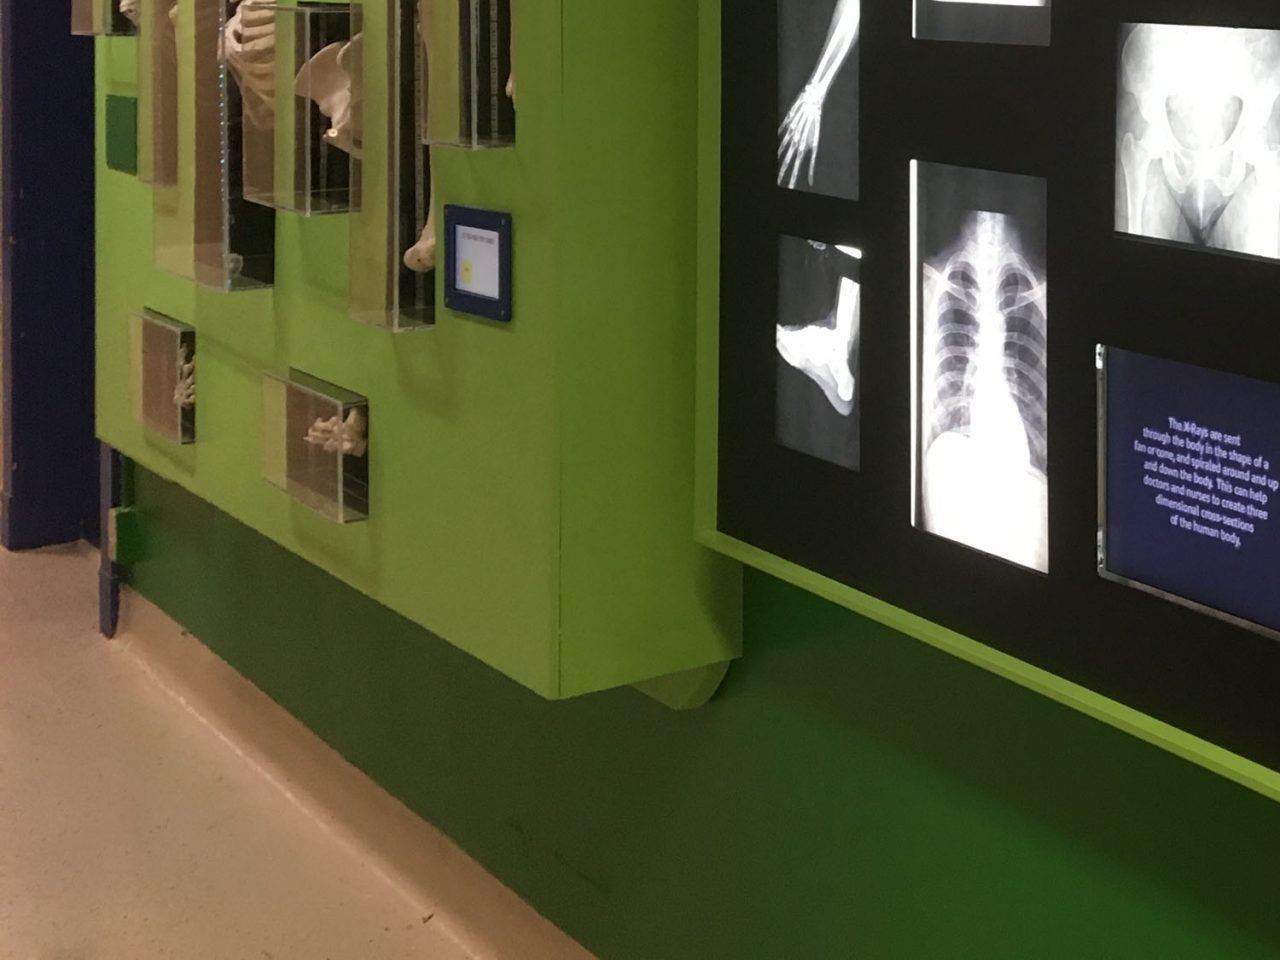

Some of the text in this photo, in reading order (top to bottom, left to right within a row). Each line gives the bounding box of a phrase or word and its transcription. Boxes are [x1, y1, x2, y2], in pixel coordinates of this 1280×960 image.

[1143, 426, 1270, 470] through the body in the shape of a
[1168, 416, 1183, 431] The
[1209, 430, 1223, 442] are
[1223, 434, 1241, 447] sent
[1134, 439, 1147, 453] fan
[1176, 453, 1191, 465] and
[1191, 457, 1221, 474] spiraled
[1222, 466, 1250, 482] around
[1251, 474, 1267, 486] and
[1267, 479, 1279, 492] up
[1143, 460, 1158, 472] and
[1158, 463, 1179, 478] down
[1180, 469, 1193, 482] the
[1216, 477, 1233, 494] This
[1234, 485, 1249, 498] can
[1249, 487, 1268, 506] help
[1143, 474, 1268, 520] doctors and nurses to create three
[1155, 493, 1200, 517] dimensional
[1170, 514, 1179, 526] of
[1179, 516, 1193, 530] the
[1193, 519, 1219, 539] human
